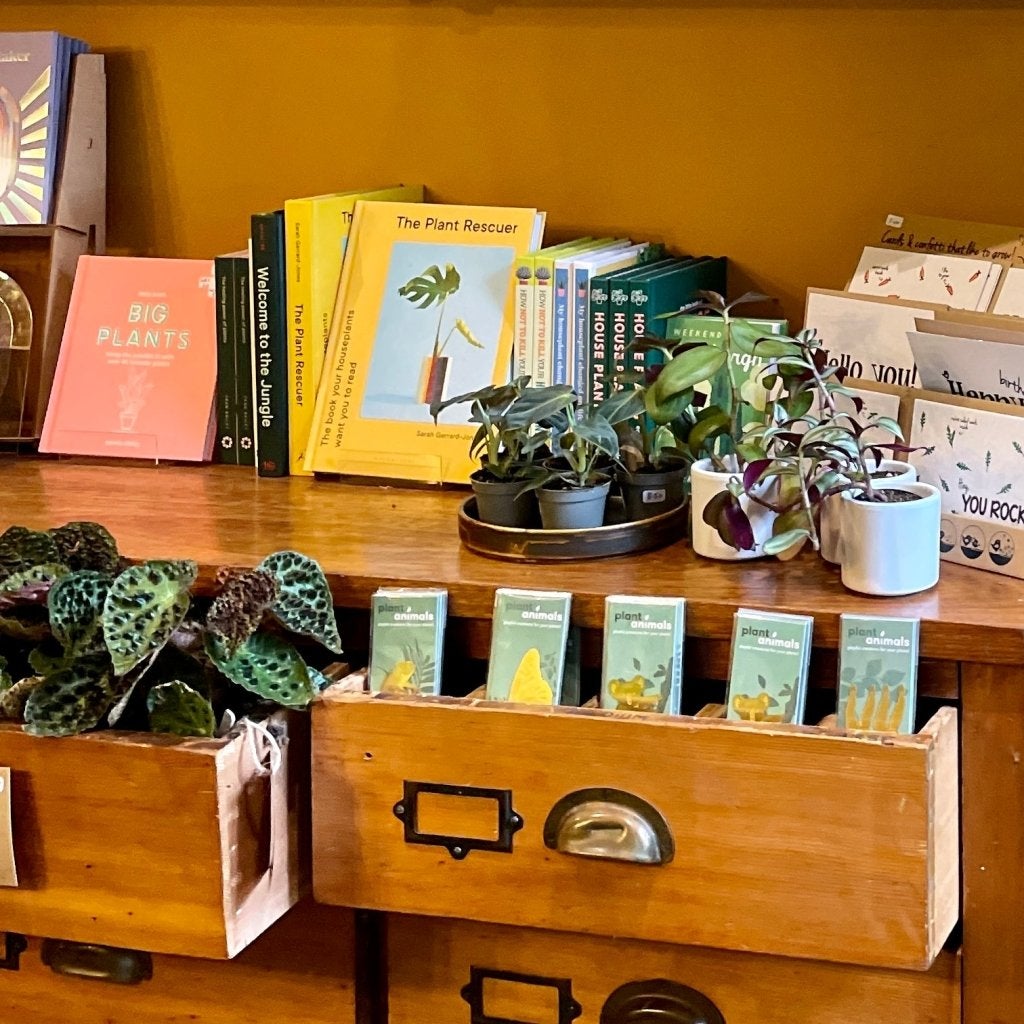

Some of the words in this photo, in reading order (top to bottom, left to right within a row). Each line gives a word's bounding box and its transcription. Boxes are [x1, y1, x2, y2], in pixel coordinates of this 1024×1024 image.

[342, 211, 353, 225] Th
[397, 216, 421, 230] The
[425, 217, 459, 232] Plant
[463, 219, 518, 234] Rescuer
[982, 248, 990, 258] to
[257, 266, 271, 331] Welcome
[519, 289, 528, 308] HOW
[538, 289, 547, 308] HOW
[128, 302, 169, 324] BIG
[295, 304, 304, 324] The
[519, 308, 528, 326] NOT
[538, 308, 546, 326] NOT
[96, 327, 191, 350] PLANTS
[258, 334, 271, 349] to
[336, 309, 355, 372] houseplants
[519, 326, 528, 338] TO
[538, 326, 546, 338] TO
[593, 312, 605, 360] HOUSE
[613, 312, 626, 361] HOUSE
[633, 313, 645, 361] HOE
[673, 328, 722, 339] WEEKEND
[295, 328, 304, 357] Plant
[518, 339, 527, 358] KILL
[537, 339, 546, 358] KILL
[260, 352, 273, 376] the
[348, 361, 357, 386] read
[536, 359, 546, 379] YOUR
[295, 360, 304, 407] Rescuer
[332, 374, 342, 397] your
[344, 386, 352, 398] to
[593, 364, 604, 408] PLAN
[258, 379, 274, 428] Jungle
[325, 399, 336, 424] book
[341, 401, 350, 420] you
[321, 427, 332, 447] The
[335, 422, 345, 448] want
[416, 430, 434, 438] Sarah
[961, 493, 988, 516] YOU
[378, 603, 404, 614] plant
[394, 610, 434, 621] animals
[506, 601, 533, 612] plant
[521, 609, 563, 622] animals
[614, 610, 642, 623] plant
[630, 619, 672, 631] animals
[741, 626, 770, 638] plant
[847, 626, 877, 638] plant
[865, 634, 910, 647] animals
[757, 635, 800, 650] animals
